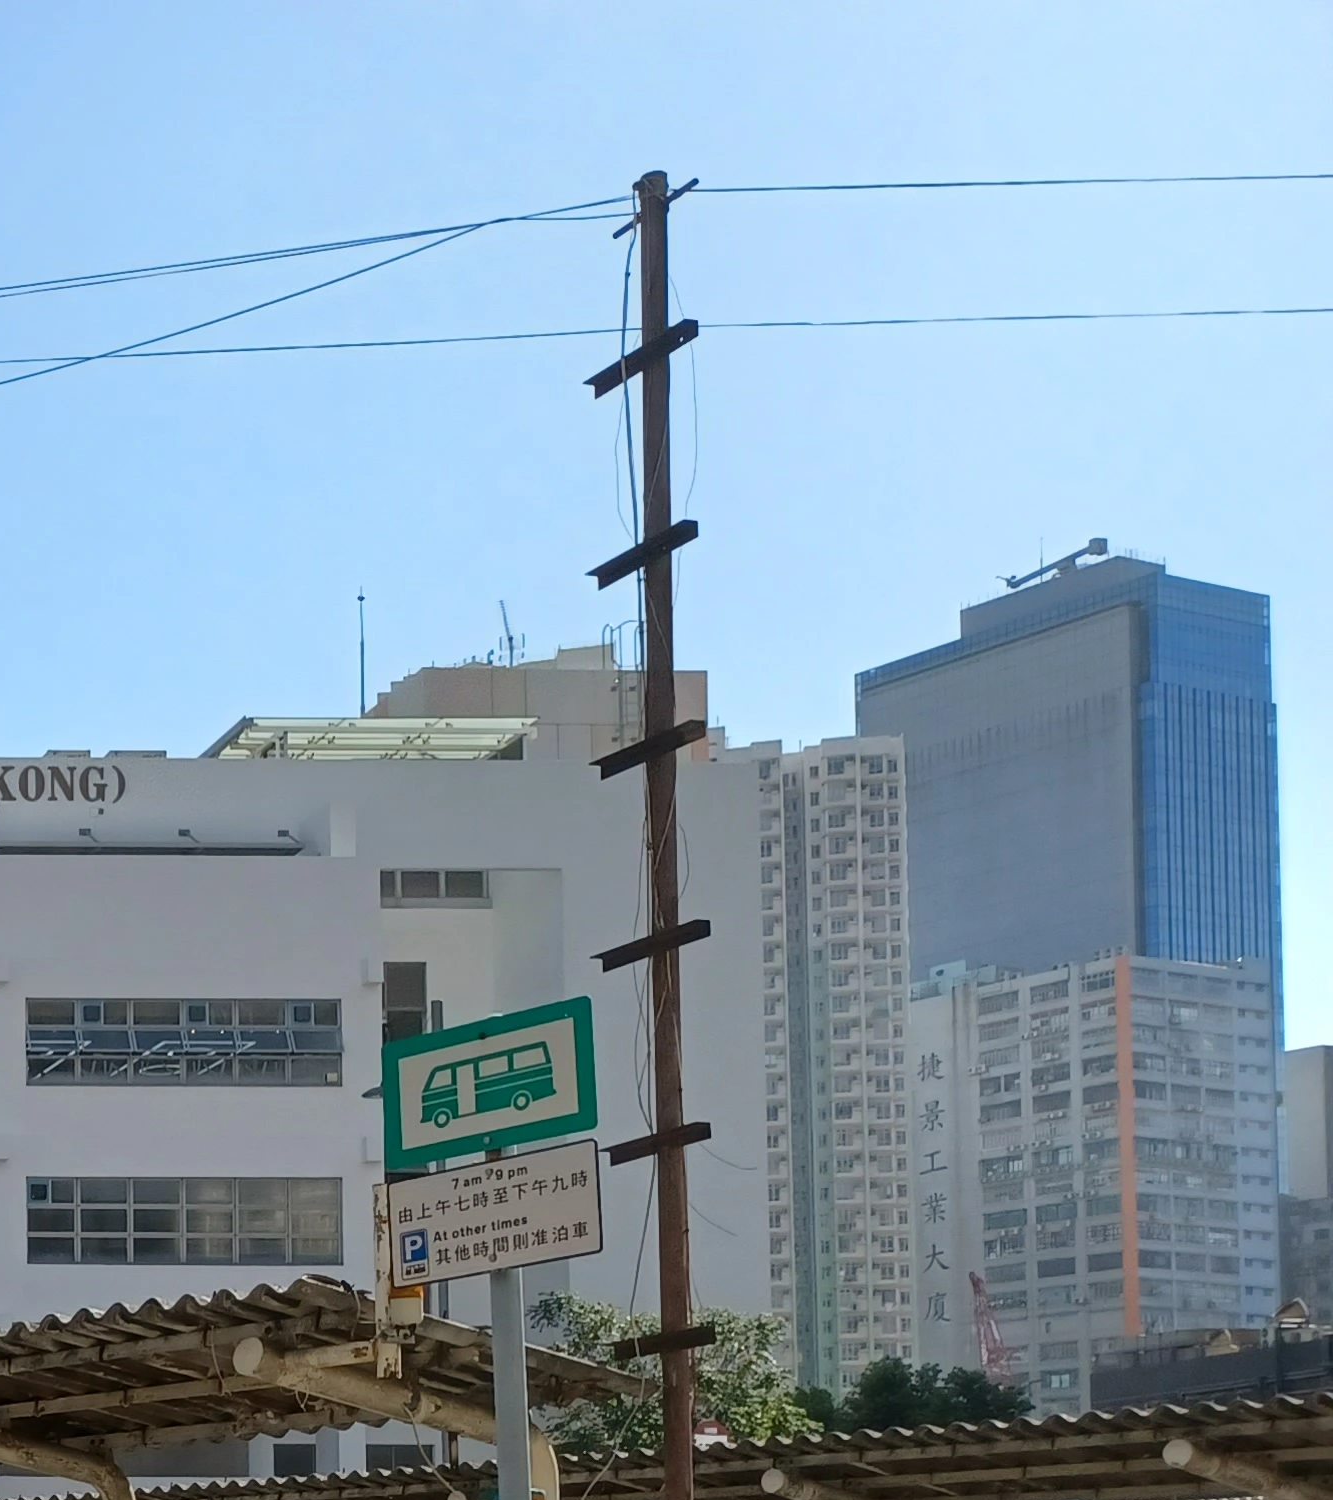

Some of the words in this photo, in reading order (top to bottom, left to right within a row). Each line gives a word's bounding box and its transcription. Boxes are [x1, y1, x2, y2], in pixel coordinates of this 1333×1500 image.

[398, 1170, 588, 1224] 由上午七時至下午九時
[451, 1177, 459, 1190] 7
[463, 1176, 482, 1188] am
[507, 1166, 529, 1180] pm
[917, 1052, 951, 1323] 捷景工業大廈
[433, 1230, 448, 1243] At
[452, 1223, 487, 1239] other
[491, 1216, 528, 1231] times
[436, 1221, 589, 1266] 其他時間則准泊車
